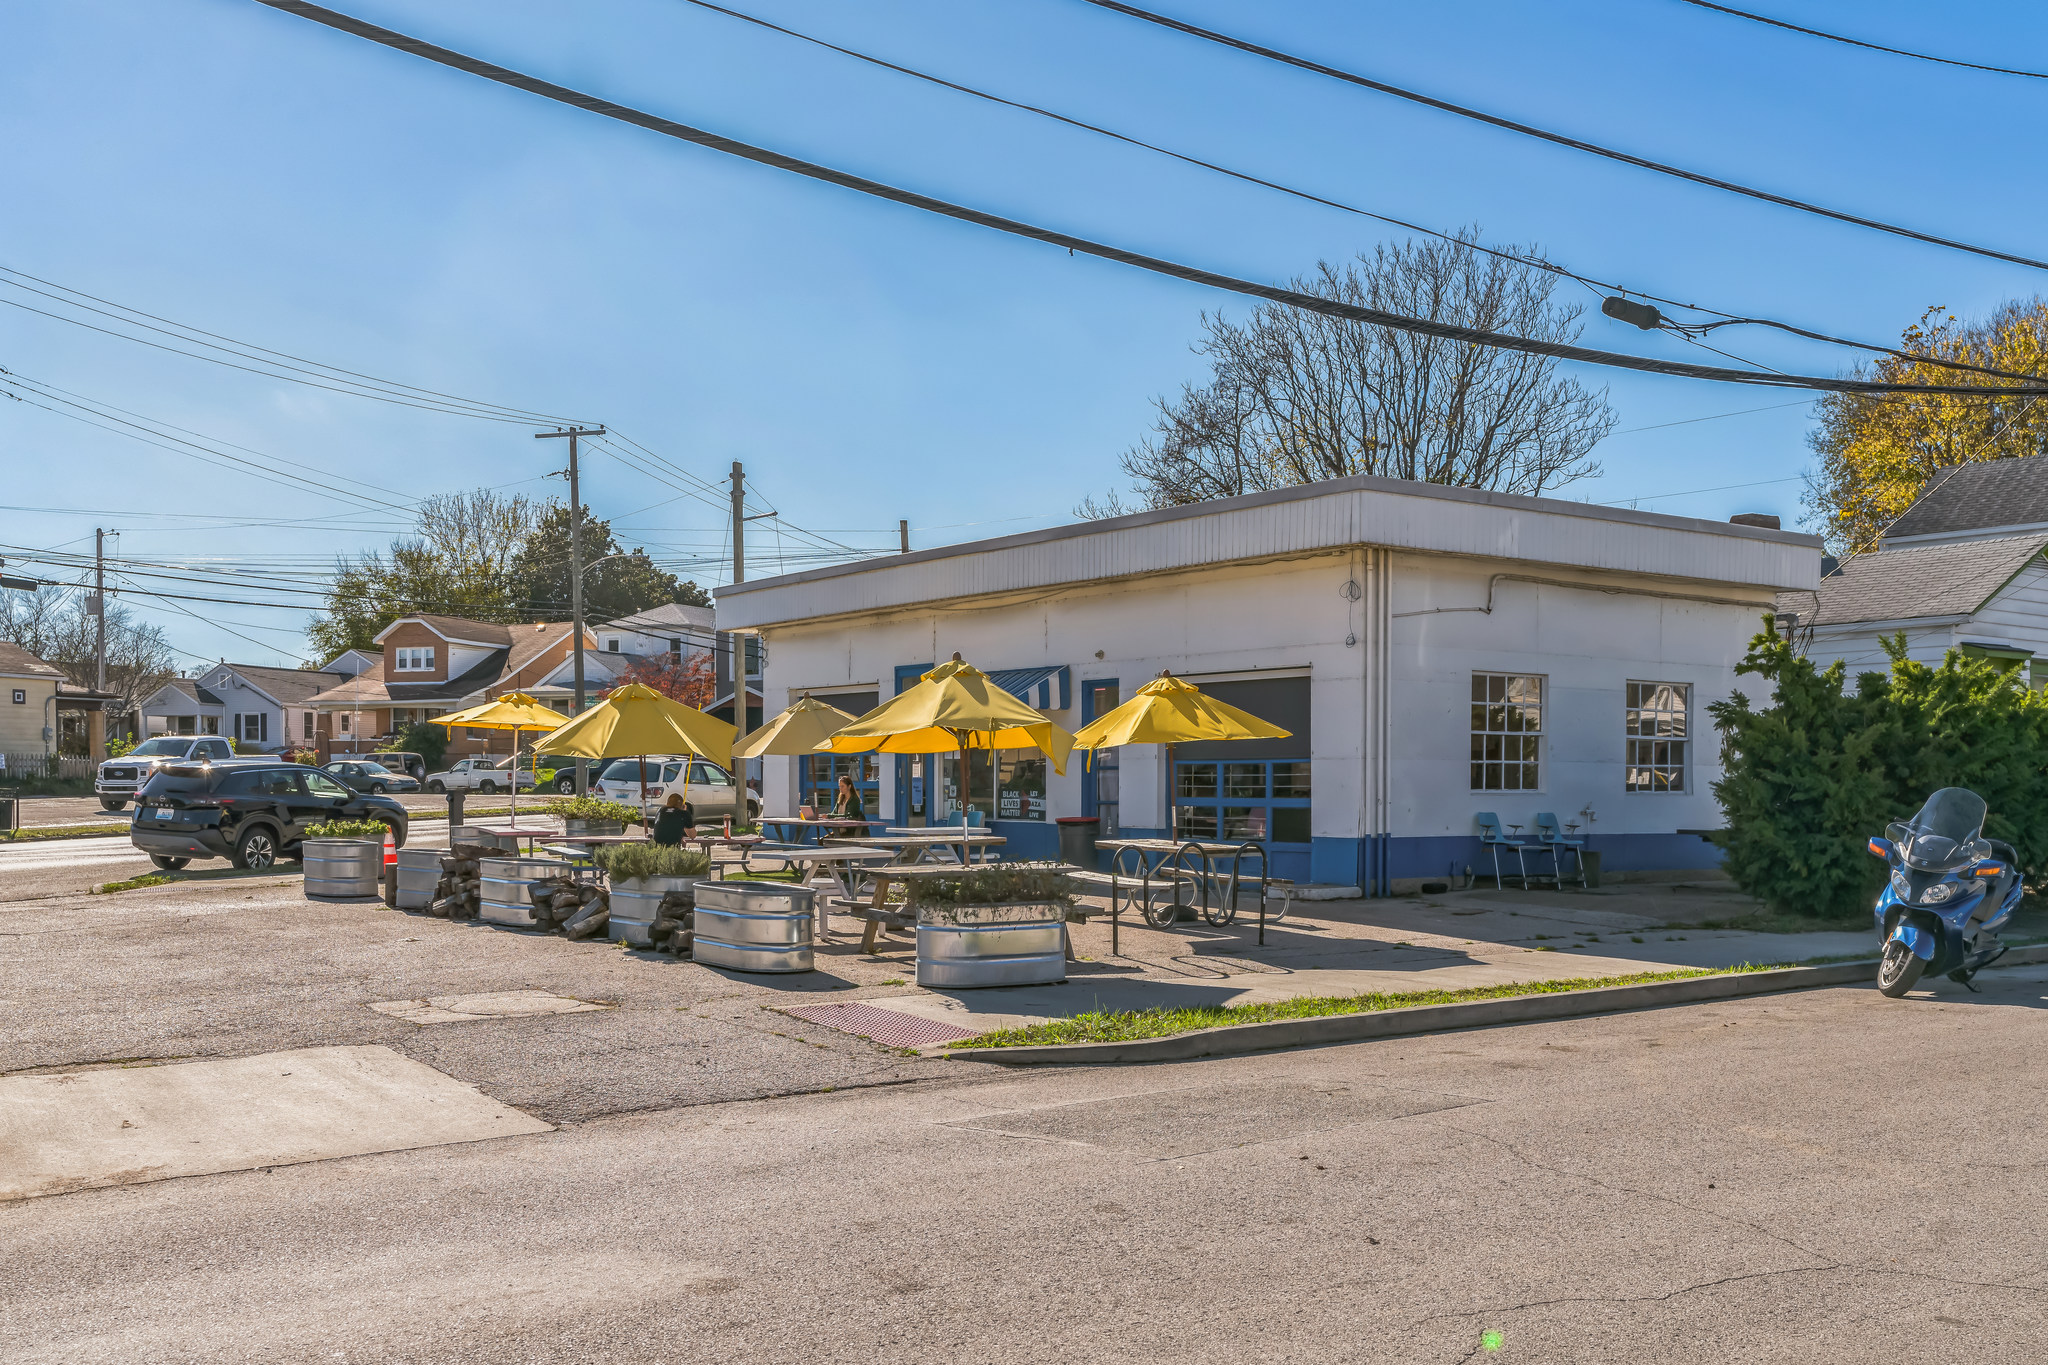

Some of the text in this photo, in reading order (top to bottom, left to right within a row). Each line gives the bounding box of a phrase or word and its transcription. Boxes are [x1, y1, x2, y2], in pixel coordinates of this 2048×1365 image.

[1002, 790, 1020, 798] BLACK
[1001, 809, 1020, 817] MATTER
[1029, 811, 1039, 819] LIVE
